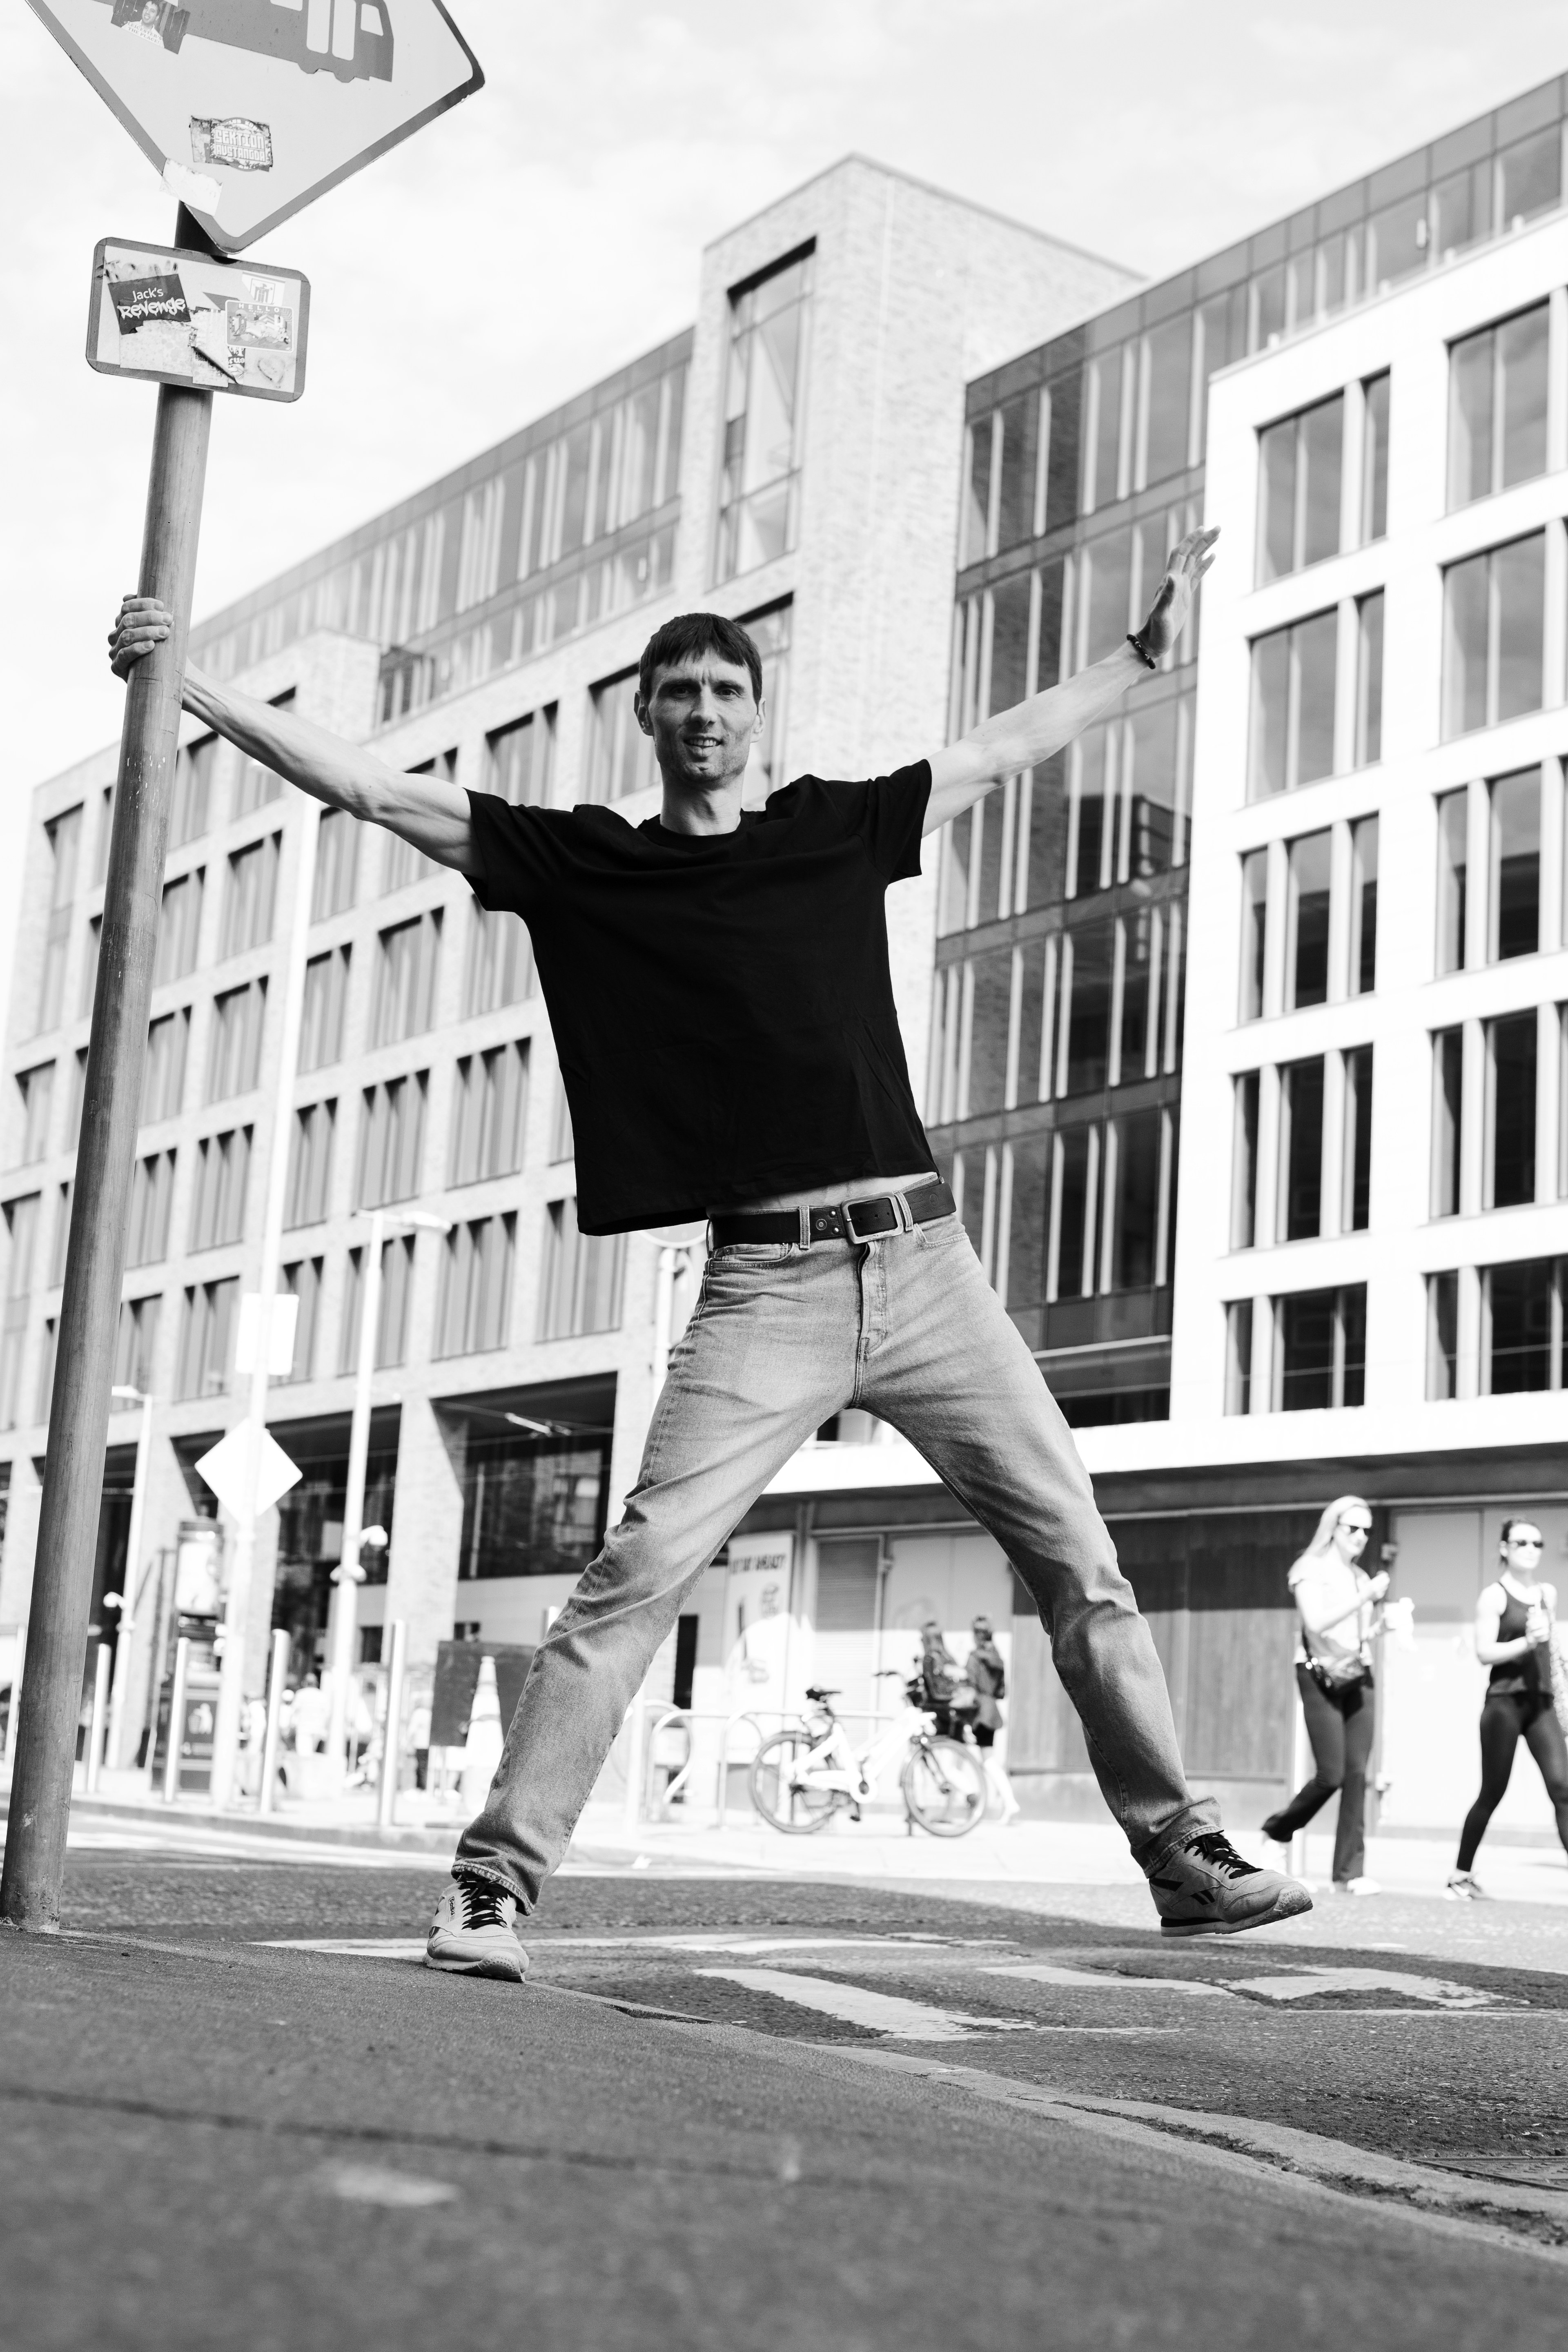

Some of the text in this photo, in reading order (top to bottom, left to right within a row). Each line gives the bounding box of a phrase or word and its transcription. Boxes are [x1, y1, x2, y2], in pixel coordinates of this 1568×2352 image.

[128, 21, 162, 40] LEICESTER'S
[140, 32, 160, 44] PLACE!
[215, 129, 265, 149] SEKTION
[132, 287, 164, 303] Jack's
[117, 297, 186, 320] Revenge
[238, 303, 280, 313] HELLO
